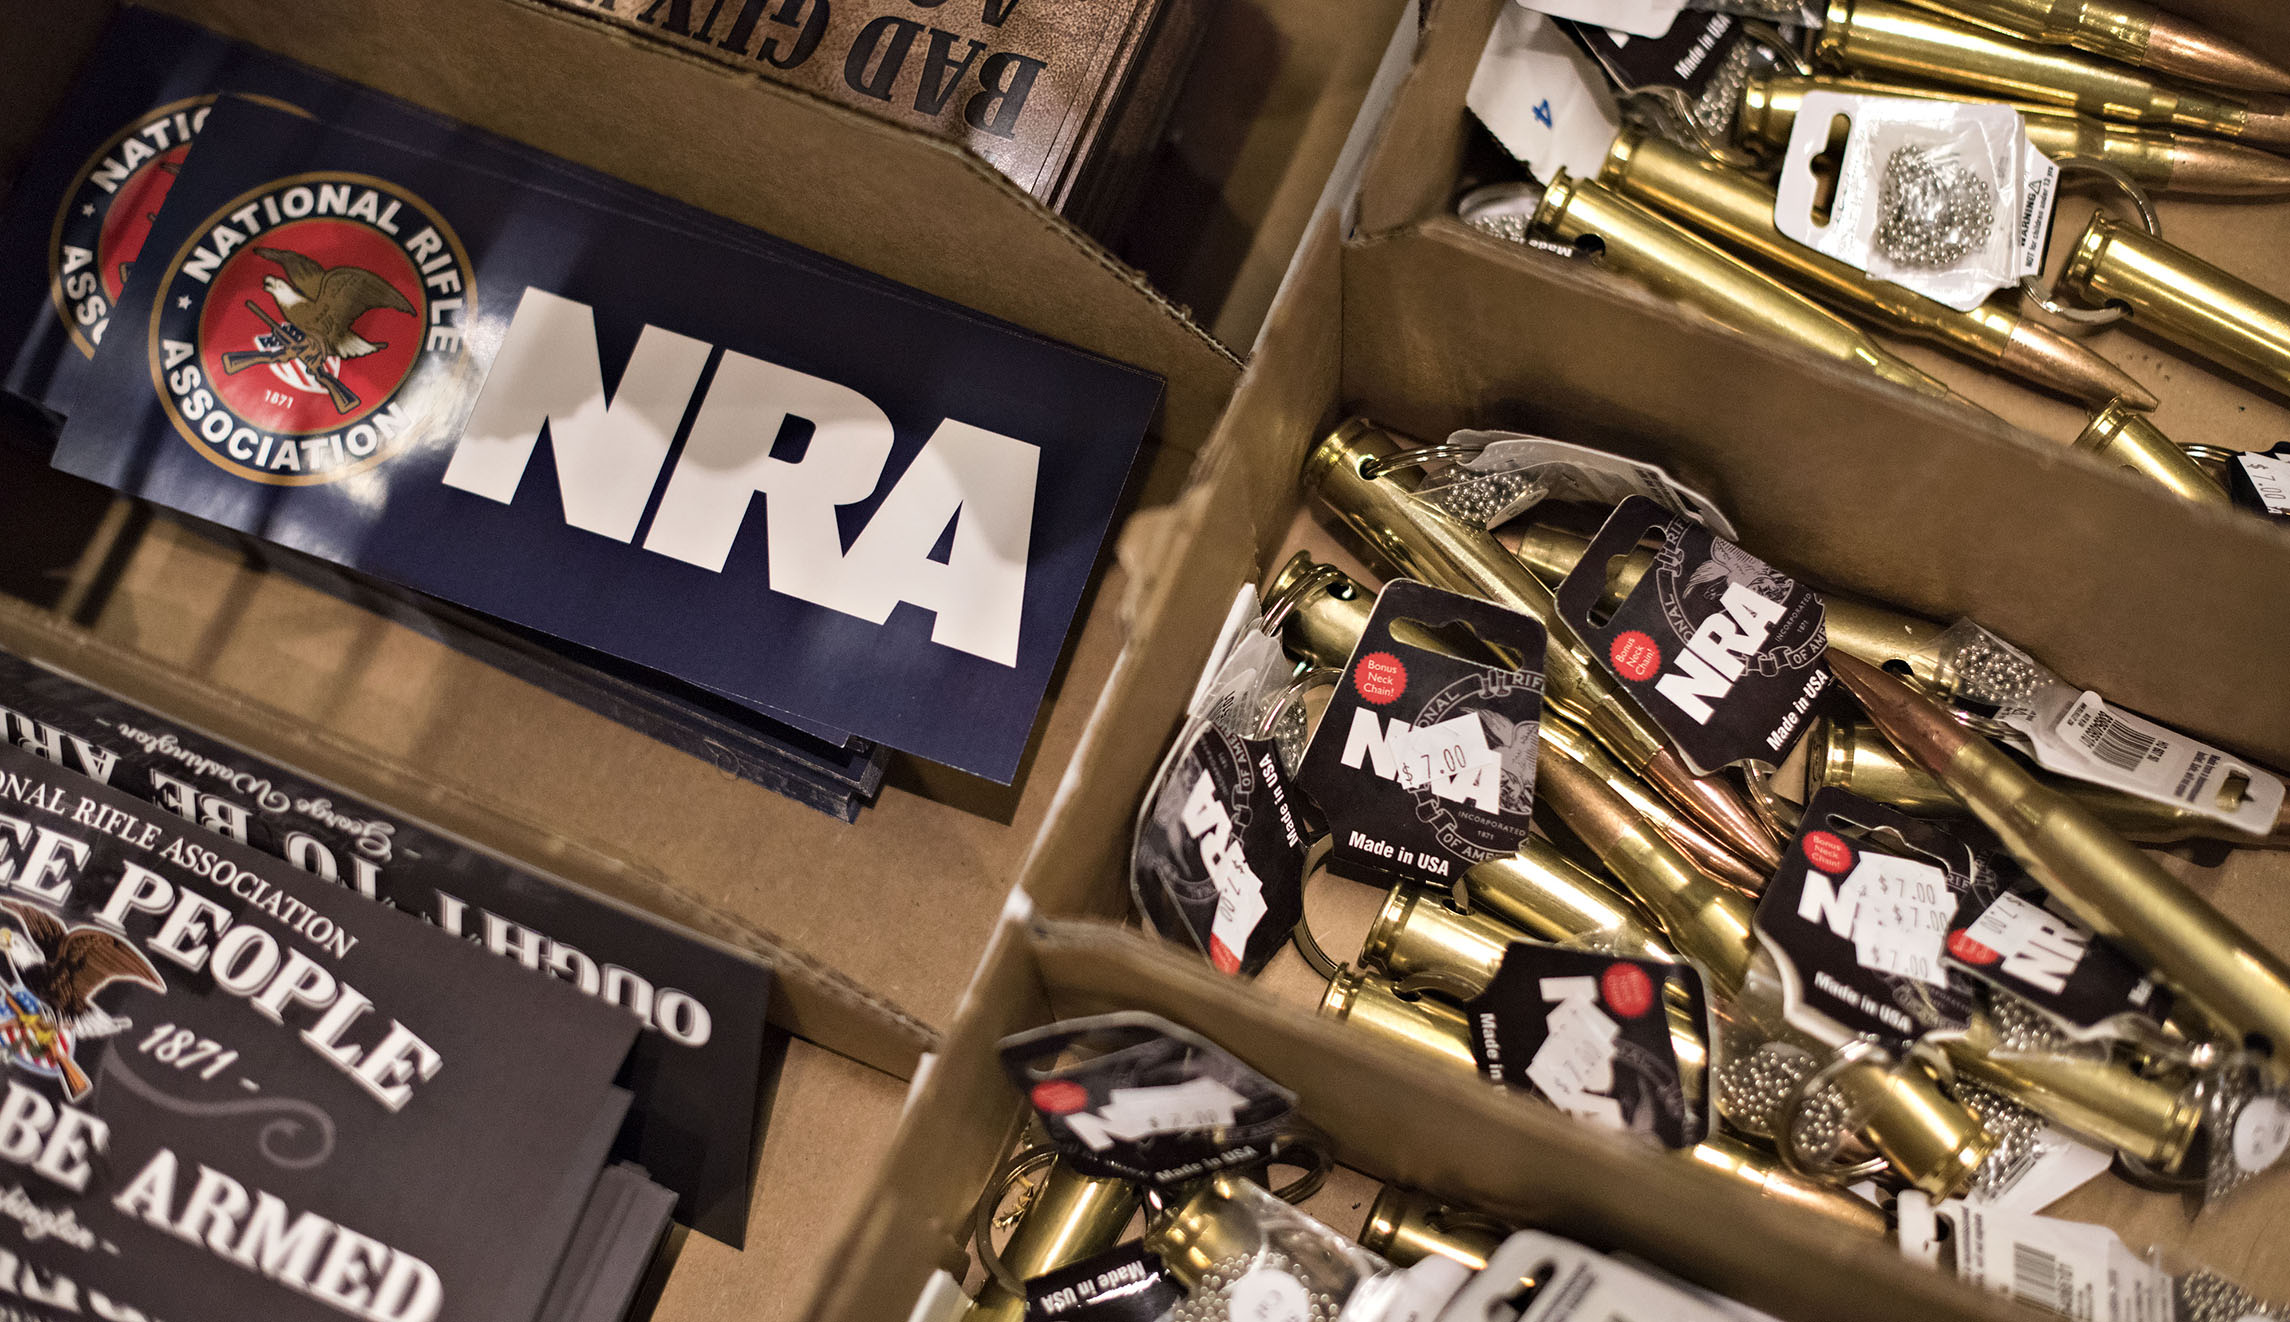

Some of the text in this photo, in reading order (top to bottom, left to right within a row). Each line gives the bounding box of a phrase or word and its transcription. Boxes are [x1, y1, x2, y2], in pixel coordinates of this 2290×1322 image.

[1674, 10, 1733, 80] Made in USA
[843, 15, 1047, 140] BAD
[182, 184, 464, 355] NATIONAL RIFLE
[161, 338, 413, 473] ASSOCIATION
[264, 390, 294, 409] 1871
[441, 285, 1042, 669] NRA
[1667, 519, 1691, 546] RIF
[1773, 592, 1813, 643] INCORPORATED
[1367, 659, 1398, 674] Bonus
[1615, 637, 1636, 663] Bonus
[1626, 645, 1645, 668] Neck
[1635, 648, 1655, 676] Chain!
[1654, 581, 1788, 726] NRA
[1792, 623, 1827, 664] OF AME
[1362, 682, 1395, 697] Chain!
[1367, 671, 1394, 686] Neck
[1766, 669, 1830, 751] Made in USA
[1240, 768, 1252, 787] OF
[1420, 744, 1467, 779] 7.00
[150, 768, 254, 847] BE
[1259, 752, 1300, 848] Made in USA
[1457, 810, 1527, 838] INCORPORATED
[295, 796, 397, 864] George
[1348, 830, 1450, 877] Made in USA
[1442, 832, 1501, 863] OF AME
[1812, 835, 1842, 852] Bonus
[72, 796, 163, 851] RIFLE
[159, 837, 359, 959] ASSOCIATION
[93, 859, 443, 1114] PEOPLE
[419, 887, 713, 1047] OUGHT
[1814, 970, 1913, 1035] Made in USA
[138, 1022, 240, 1081] 1871
[1480, 1012, 1500, 1060] Made
[1489, 1063, 1504, 1080] in
[1155, 1145, 1258, 1182] Made in USA
[0, 1080, 110, 1193] BE
[112, 1147, 444, 1322] ARMED
[1039, 1259, 1147, 1315] Made in USA
